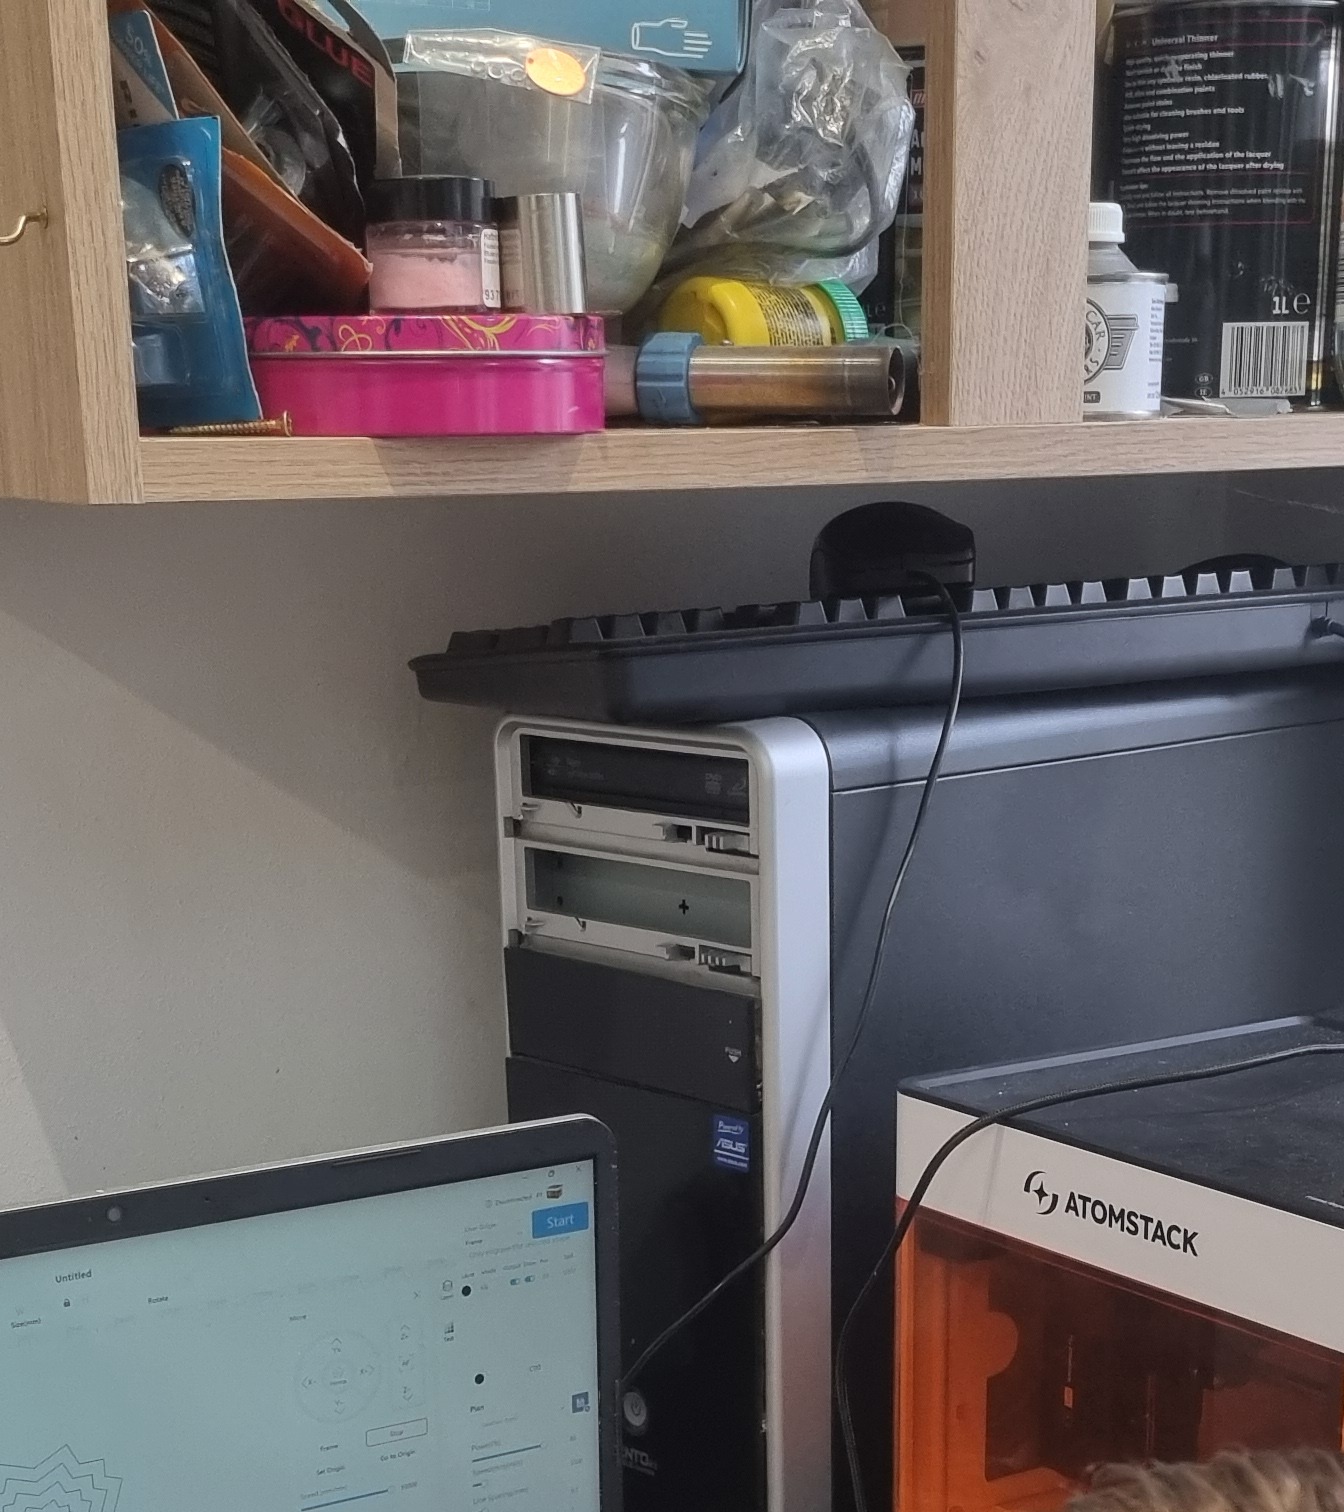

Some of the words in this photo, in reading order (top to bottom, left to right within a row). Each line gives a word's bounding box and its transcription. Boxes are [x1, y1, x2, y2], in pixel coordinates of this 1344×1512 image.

[1152, 36, 1185, 46] Universal
[1187, 34, 1218, 43] Thinner
[1272, 296, 1290, 315] 1L
[716, 1137, 748, 1153] ASUS
[546, 1214, 575, 1229] Start
[1064, 1191, 1199, 1257] ATOMSTACK
[54, 1269, 93, 1284] Untitled
[397, 1448, 416, 1458] Origin
